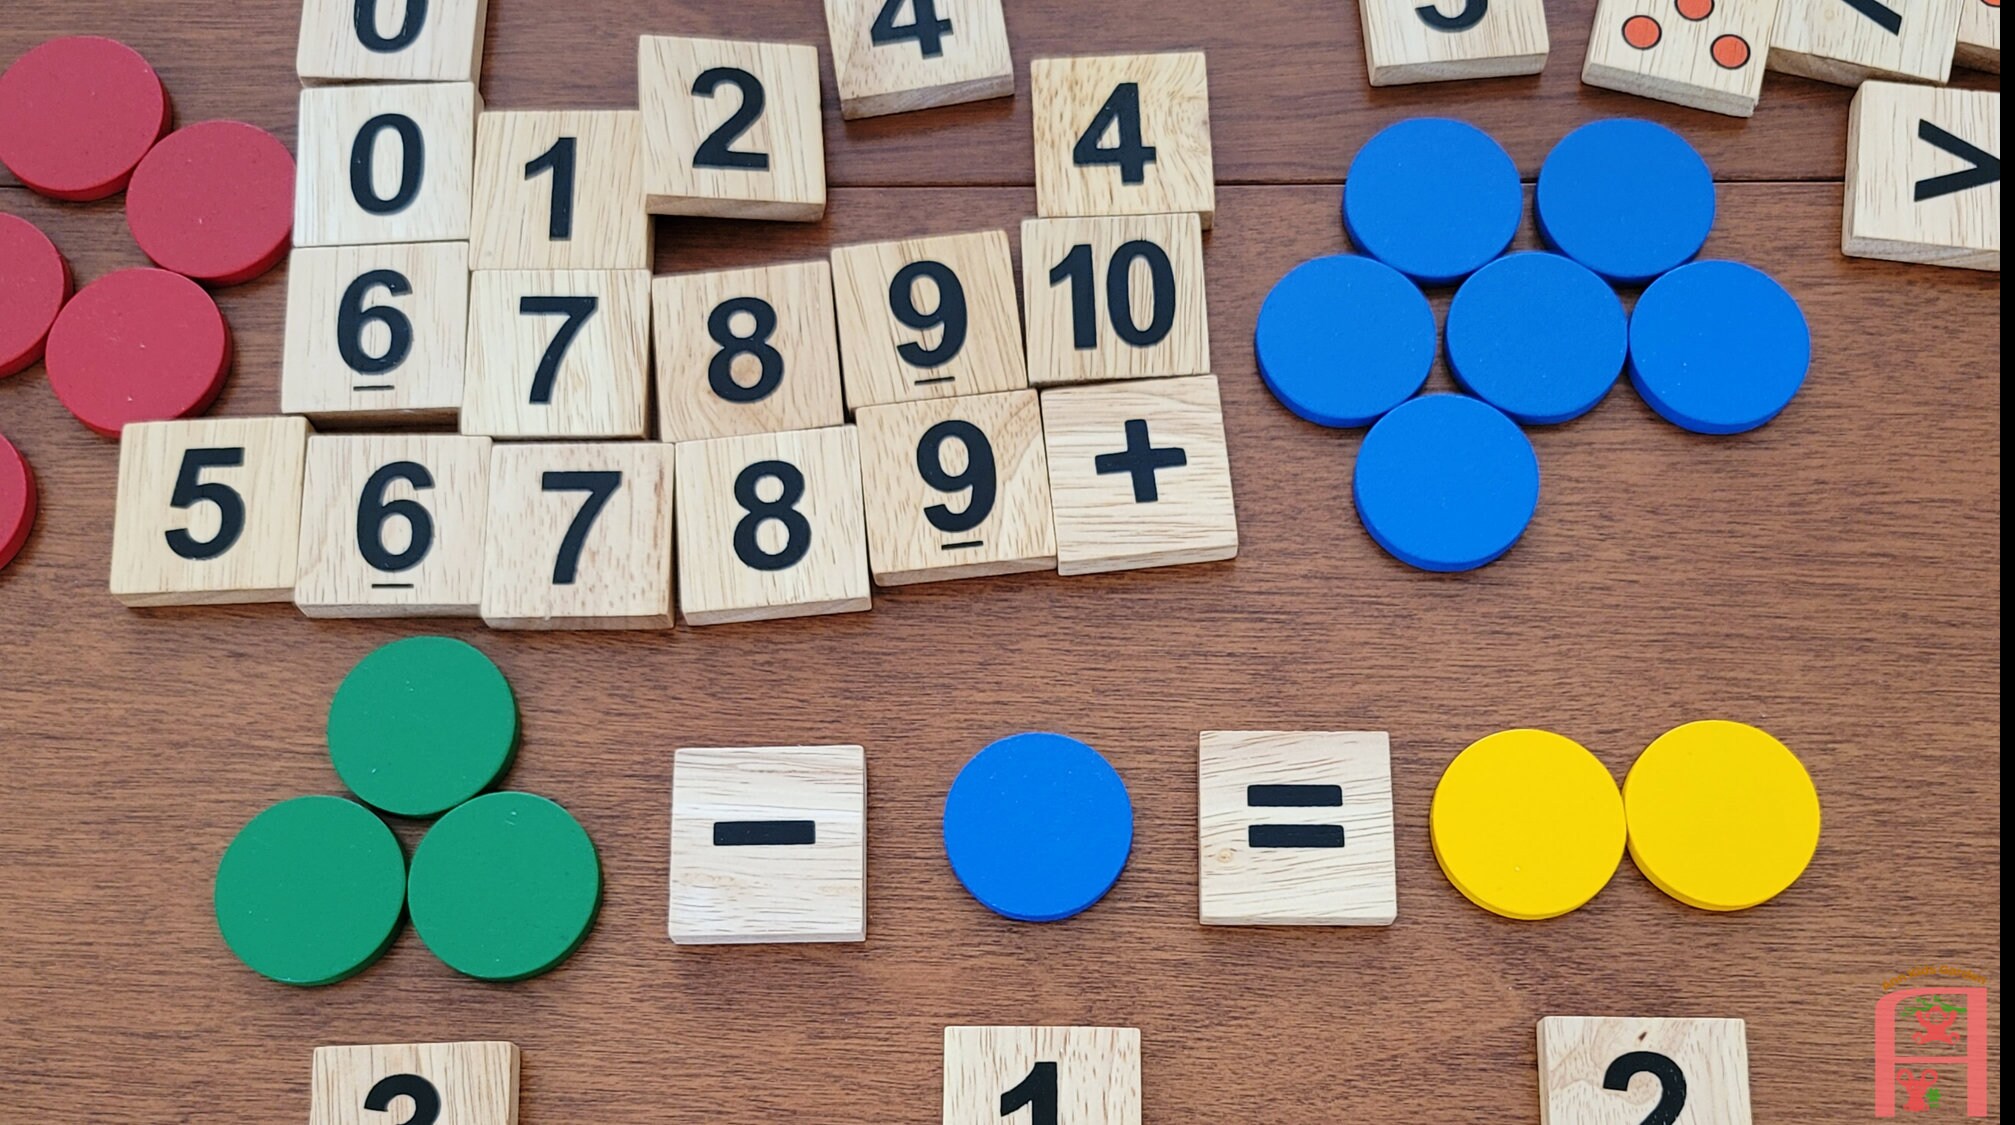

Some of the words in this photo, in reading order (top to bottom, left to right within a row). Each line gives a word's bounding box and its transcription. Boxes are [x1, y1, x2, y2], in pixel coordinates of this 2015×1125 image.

[350, 114, 421, 213] 0
[691, 67, 769, 169] 2
[1073, 83, 1156, 183] 4
[525, 137, 576, 240] 1
[338, 270, 411, 389] 6
[889, 261, 967, 384] 9
[1050, 239, 1175, 349] 10
[520, 296, 598, 404] 7
[708, 297, 783, 403] 8
[165, 447, 244, 559] 5
[357, 461, 433, 588] 6
[542, 471, 621, 584] 7
[734, 461, 811, 570] 8
[917, 420, 996, 550] 9
[1603, 1051, 1686, 1125] 2
